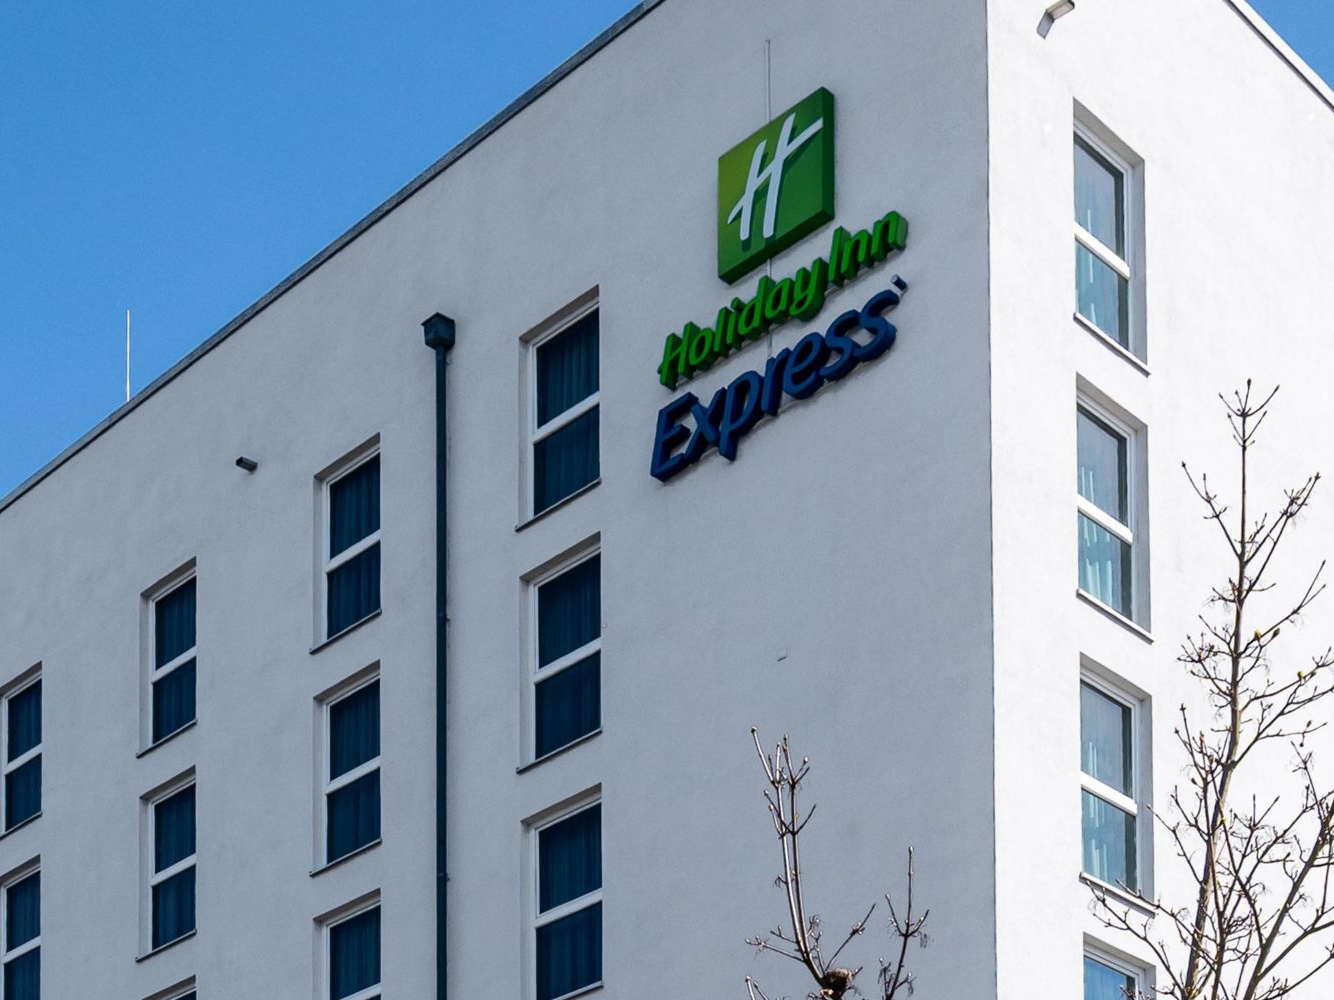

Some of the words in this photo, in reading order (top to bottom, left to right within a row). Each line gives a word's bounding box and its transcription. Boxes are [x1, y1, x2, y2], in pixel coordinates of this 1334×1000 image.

[650, 288, 901, 482] Express
[657, 257, 826, 391] Holiday
[828, 210, 908, 287] Inn
